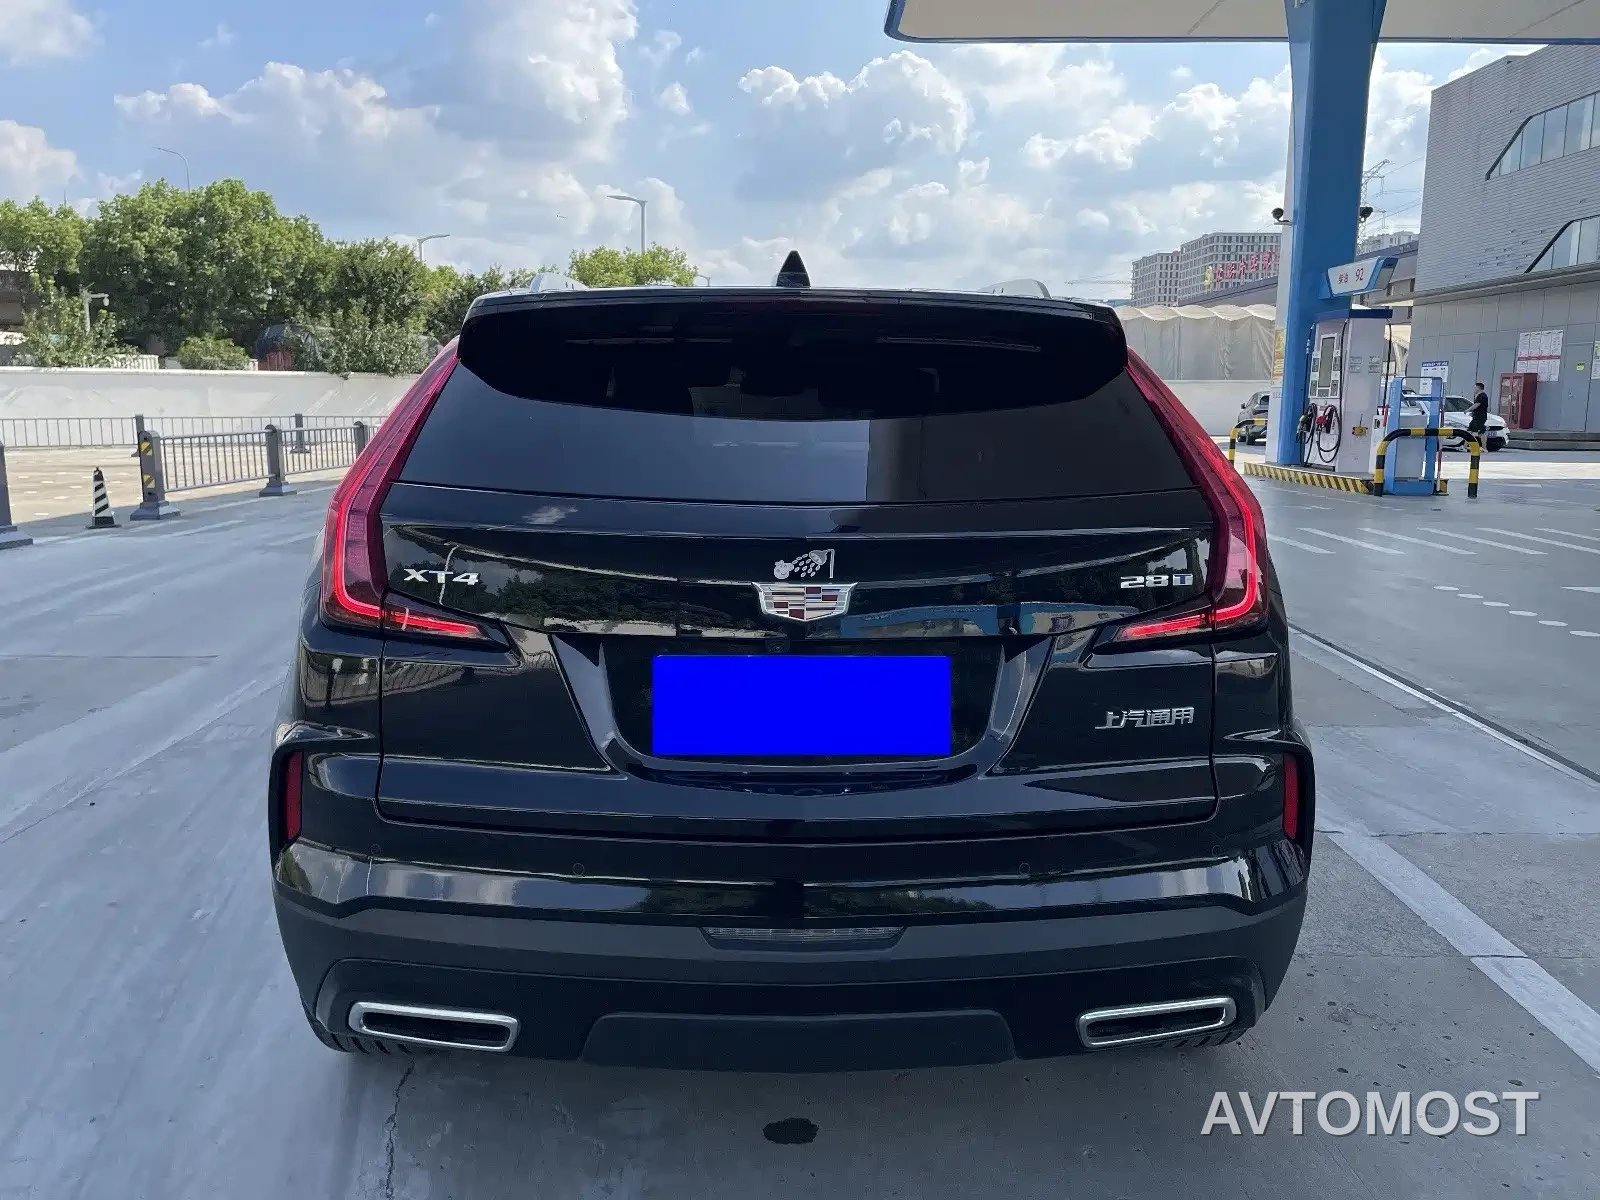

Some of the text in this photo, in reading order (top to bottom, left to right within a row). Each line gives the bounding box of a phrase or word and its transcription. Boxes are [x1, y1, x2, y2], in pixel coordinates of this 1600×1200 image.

[1355, 267, 1364, 282] 92
[403, 568, 480, 586] XT4
[1120, 573, 1194, 589] 28T
[1095, 707, 1195, 730] 上汽通用
